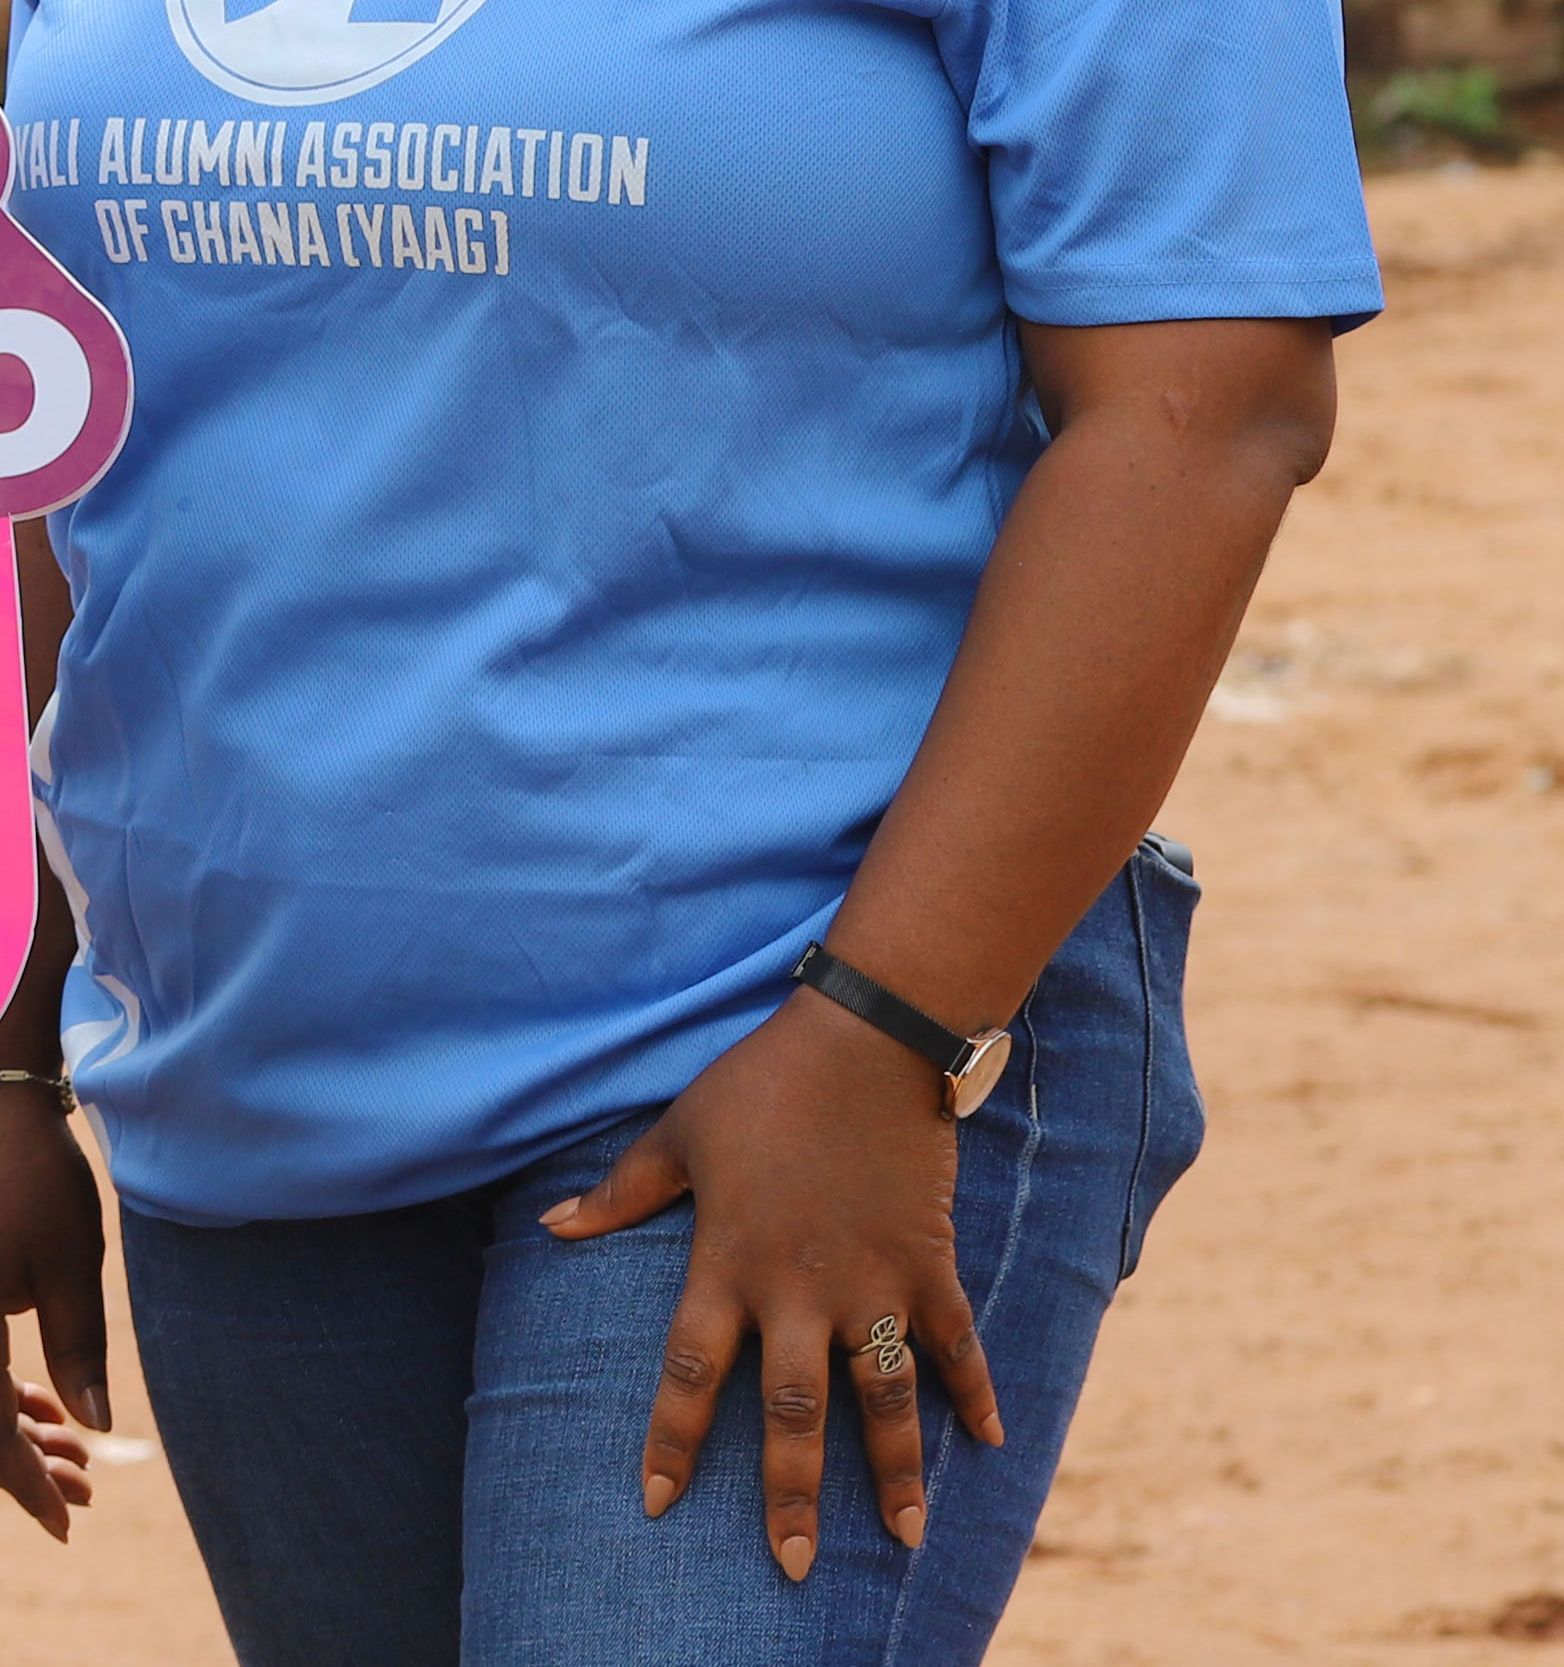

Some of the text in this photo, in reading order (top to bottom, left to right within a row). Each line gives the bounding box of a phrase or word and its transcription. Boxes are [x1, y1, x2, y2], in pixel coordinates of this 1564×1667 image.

[15, 117, 650, 207] YALI ALUMNI ASSOCIATION
[94, 199, 148, 264] OF
[161, 200, 331, 268] GHANA
